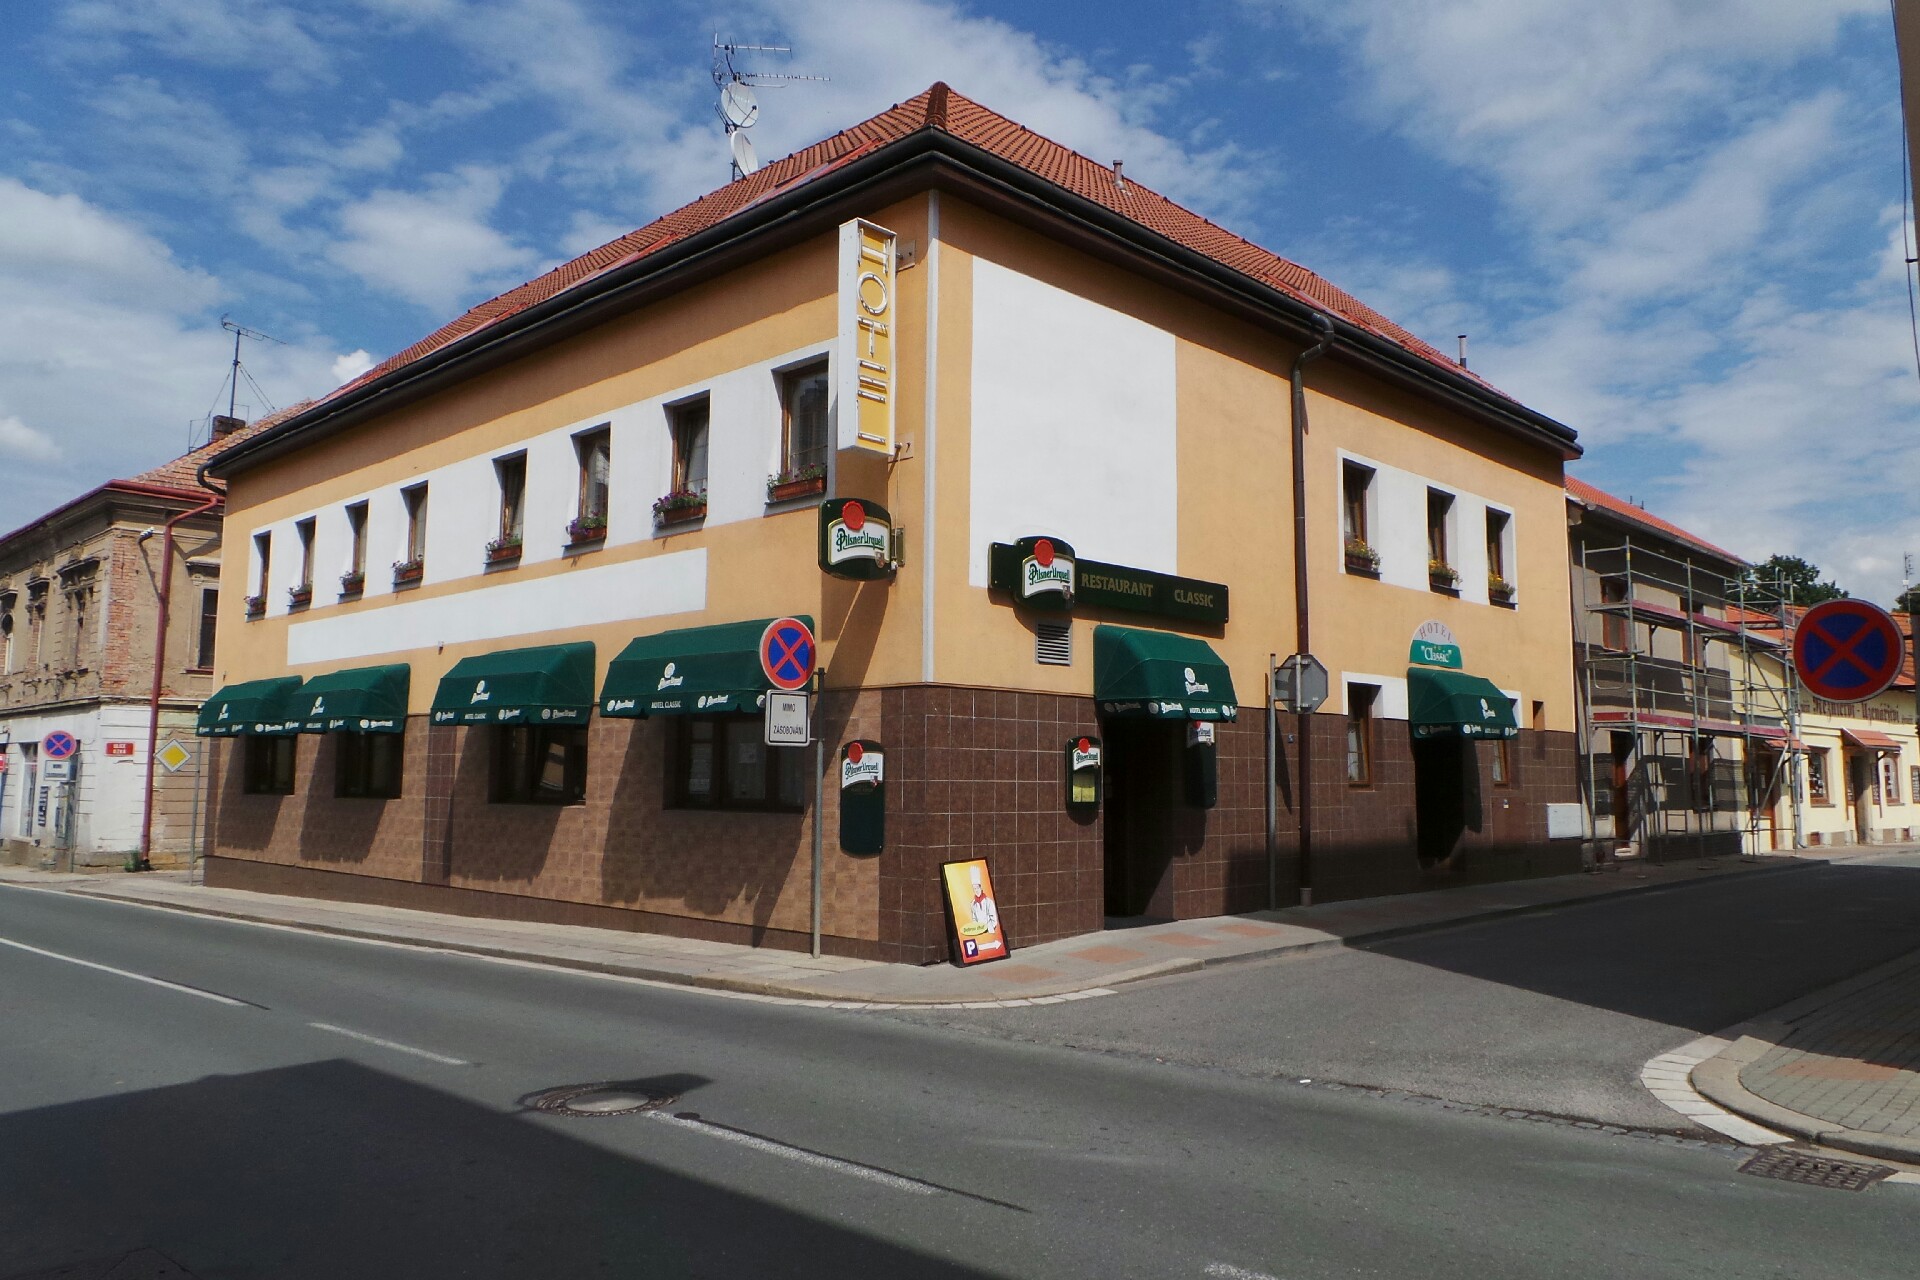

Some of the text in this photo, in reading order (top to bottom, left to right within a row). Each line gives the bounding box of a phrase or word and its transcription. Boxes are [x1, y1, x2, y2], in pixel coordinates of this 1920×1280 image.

[856, 227, 889, 443] HOTEL
[836, 527, 885, 553] Pilsner Urquell
[1028, 563, 1070, 585] Pilsner Urquell
[1081, 572, 1214, 608] RESTAURANT CLASSIC
[1419, 622, 1453, 644] HOTEL
[651, 700, 681, 709] HOTEL CLASSIC
[782, 702, 796, 713] MIMO
[773, 723, 804, 735] ZÁSOBOVÁNÍ
[845, 761, 879, 780] Pilsner Urquell
[966, 941, 975, 955] P
